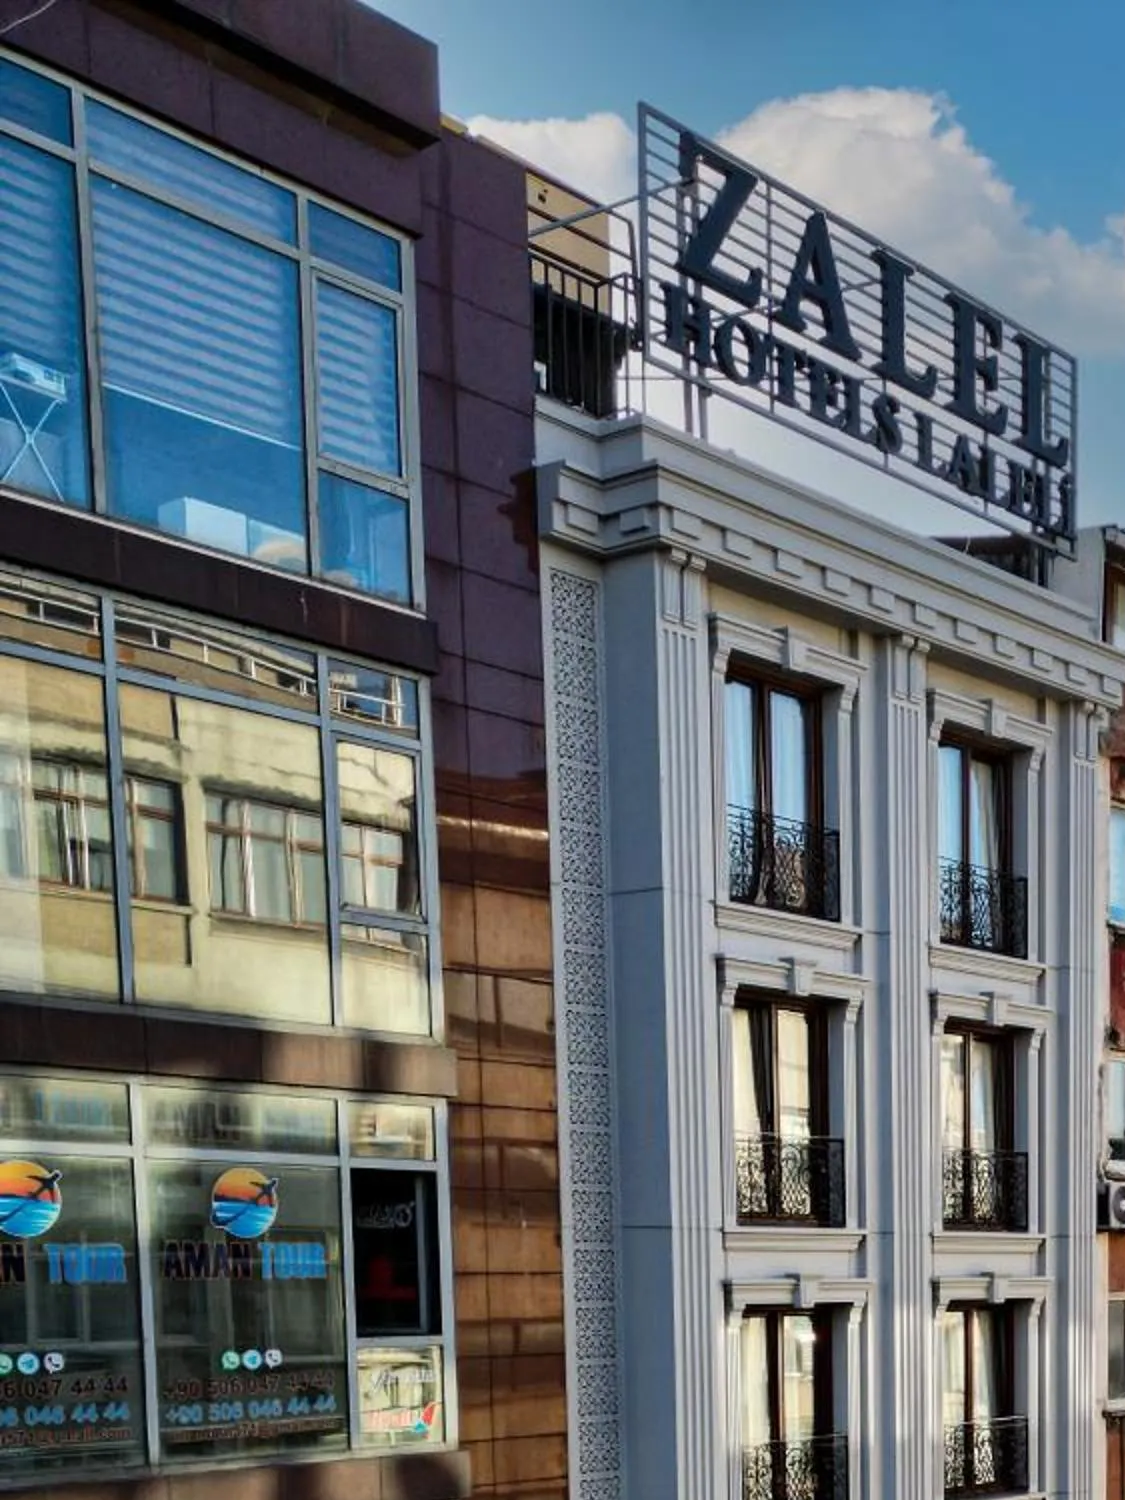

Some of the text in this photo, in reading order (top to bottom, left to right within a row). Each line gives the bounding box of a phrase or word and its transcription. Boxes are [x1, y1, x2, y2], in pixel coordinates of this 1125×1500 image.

[678, 131, 1069, 468] ZALEL
[659, 281, 903, 453] HOTELS
[43, 1242, 127, 1284] TOUR
[163, 1241, 328, 1280] AMAN TOUR
